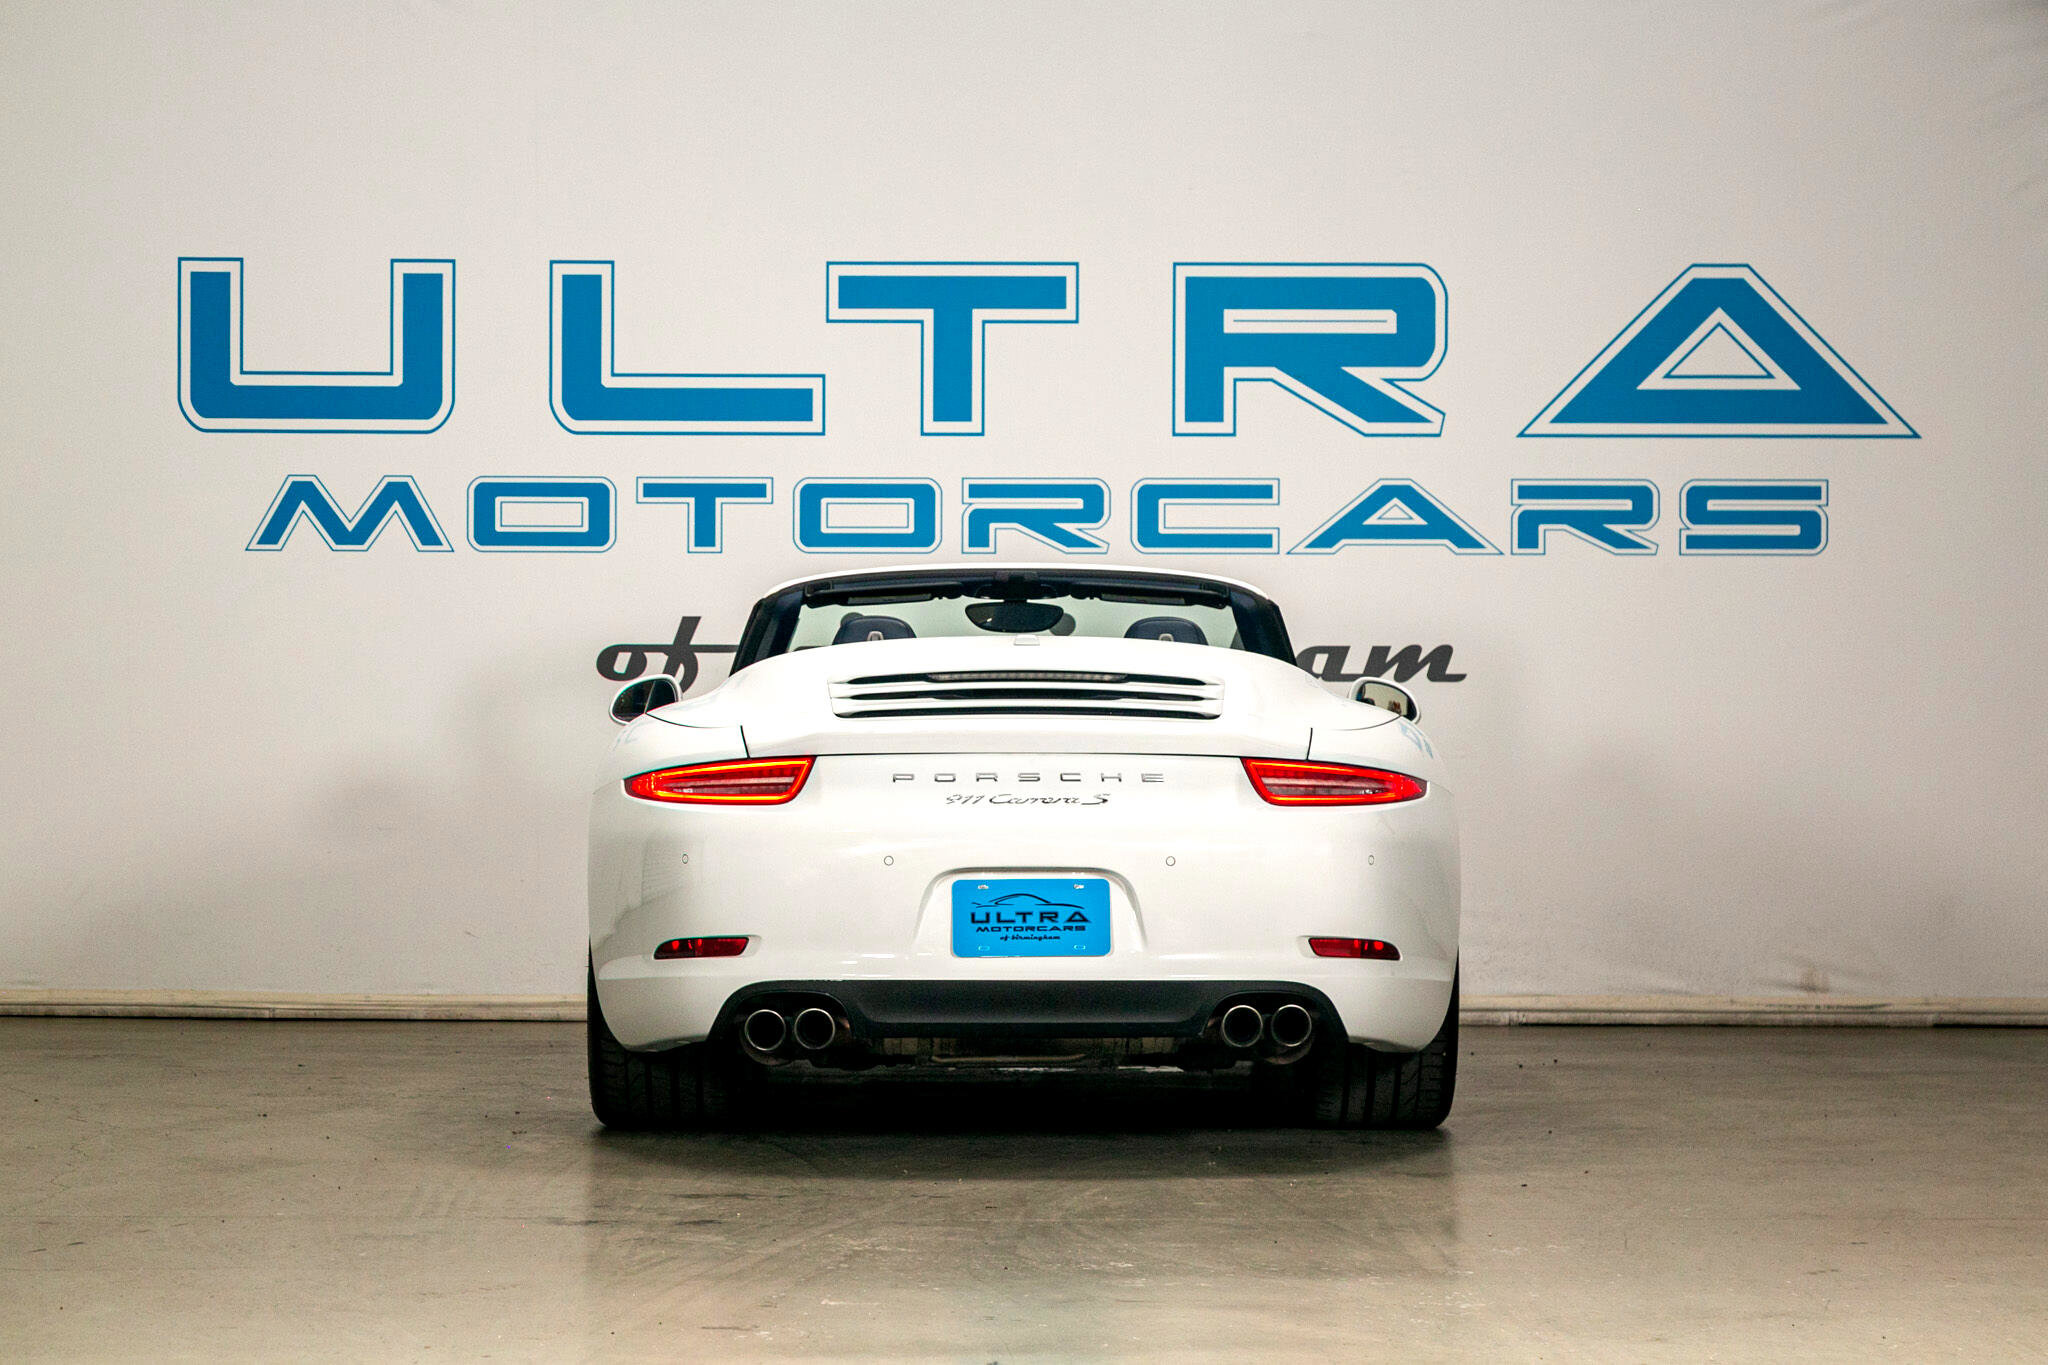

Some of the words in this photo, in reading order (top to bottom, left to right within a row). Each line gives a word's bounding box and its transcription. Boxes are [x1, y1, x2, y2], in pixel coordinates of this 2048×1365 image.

[178, 257, 1922, 439] ULTRA
[246, 474, 1830, 556] MOTORCARS
[597, 616, 736, 694] of
[892, 772, 1164, 783] PORSCHE
[946, 794, 985, 805] 911
[989, 794, 1080, 805] Carrera
[1081, 793, 1111, 805] S
[970, 911, 1091, 924] ULTRA
[1000, 934, 1010, 942] of
